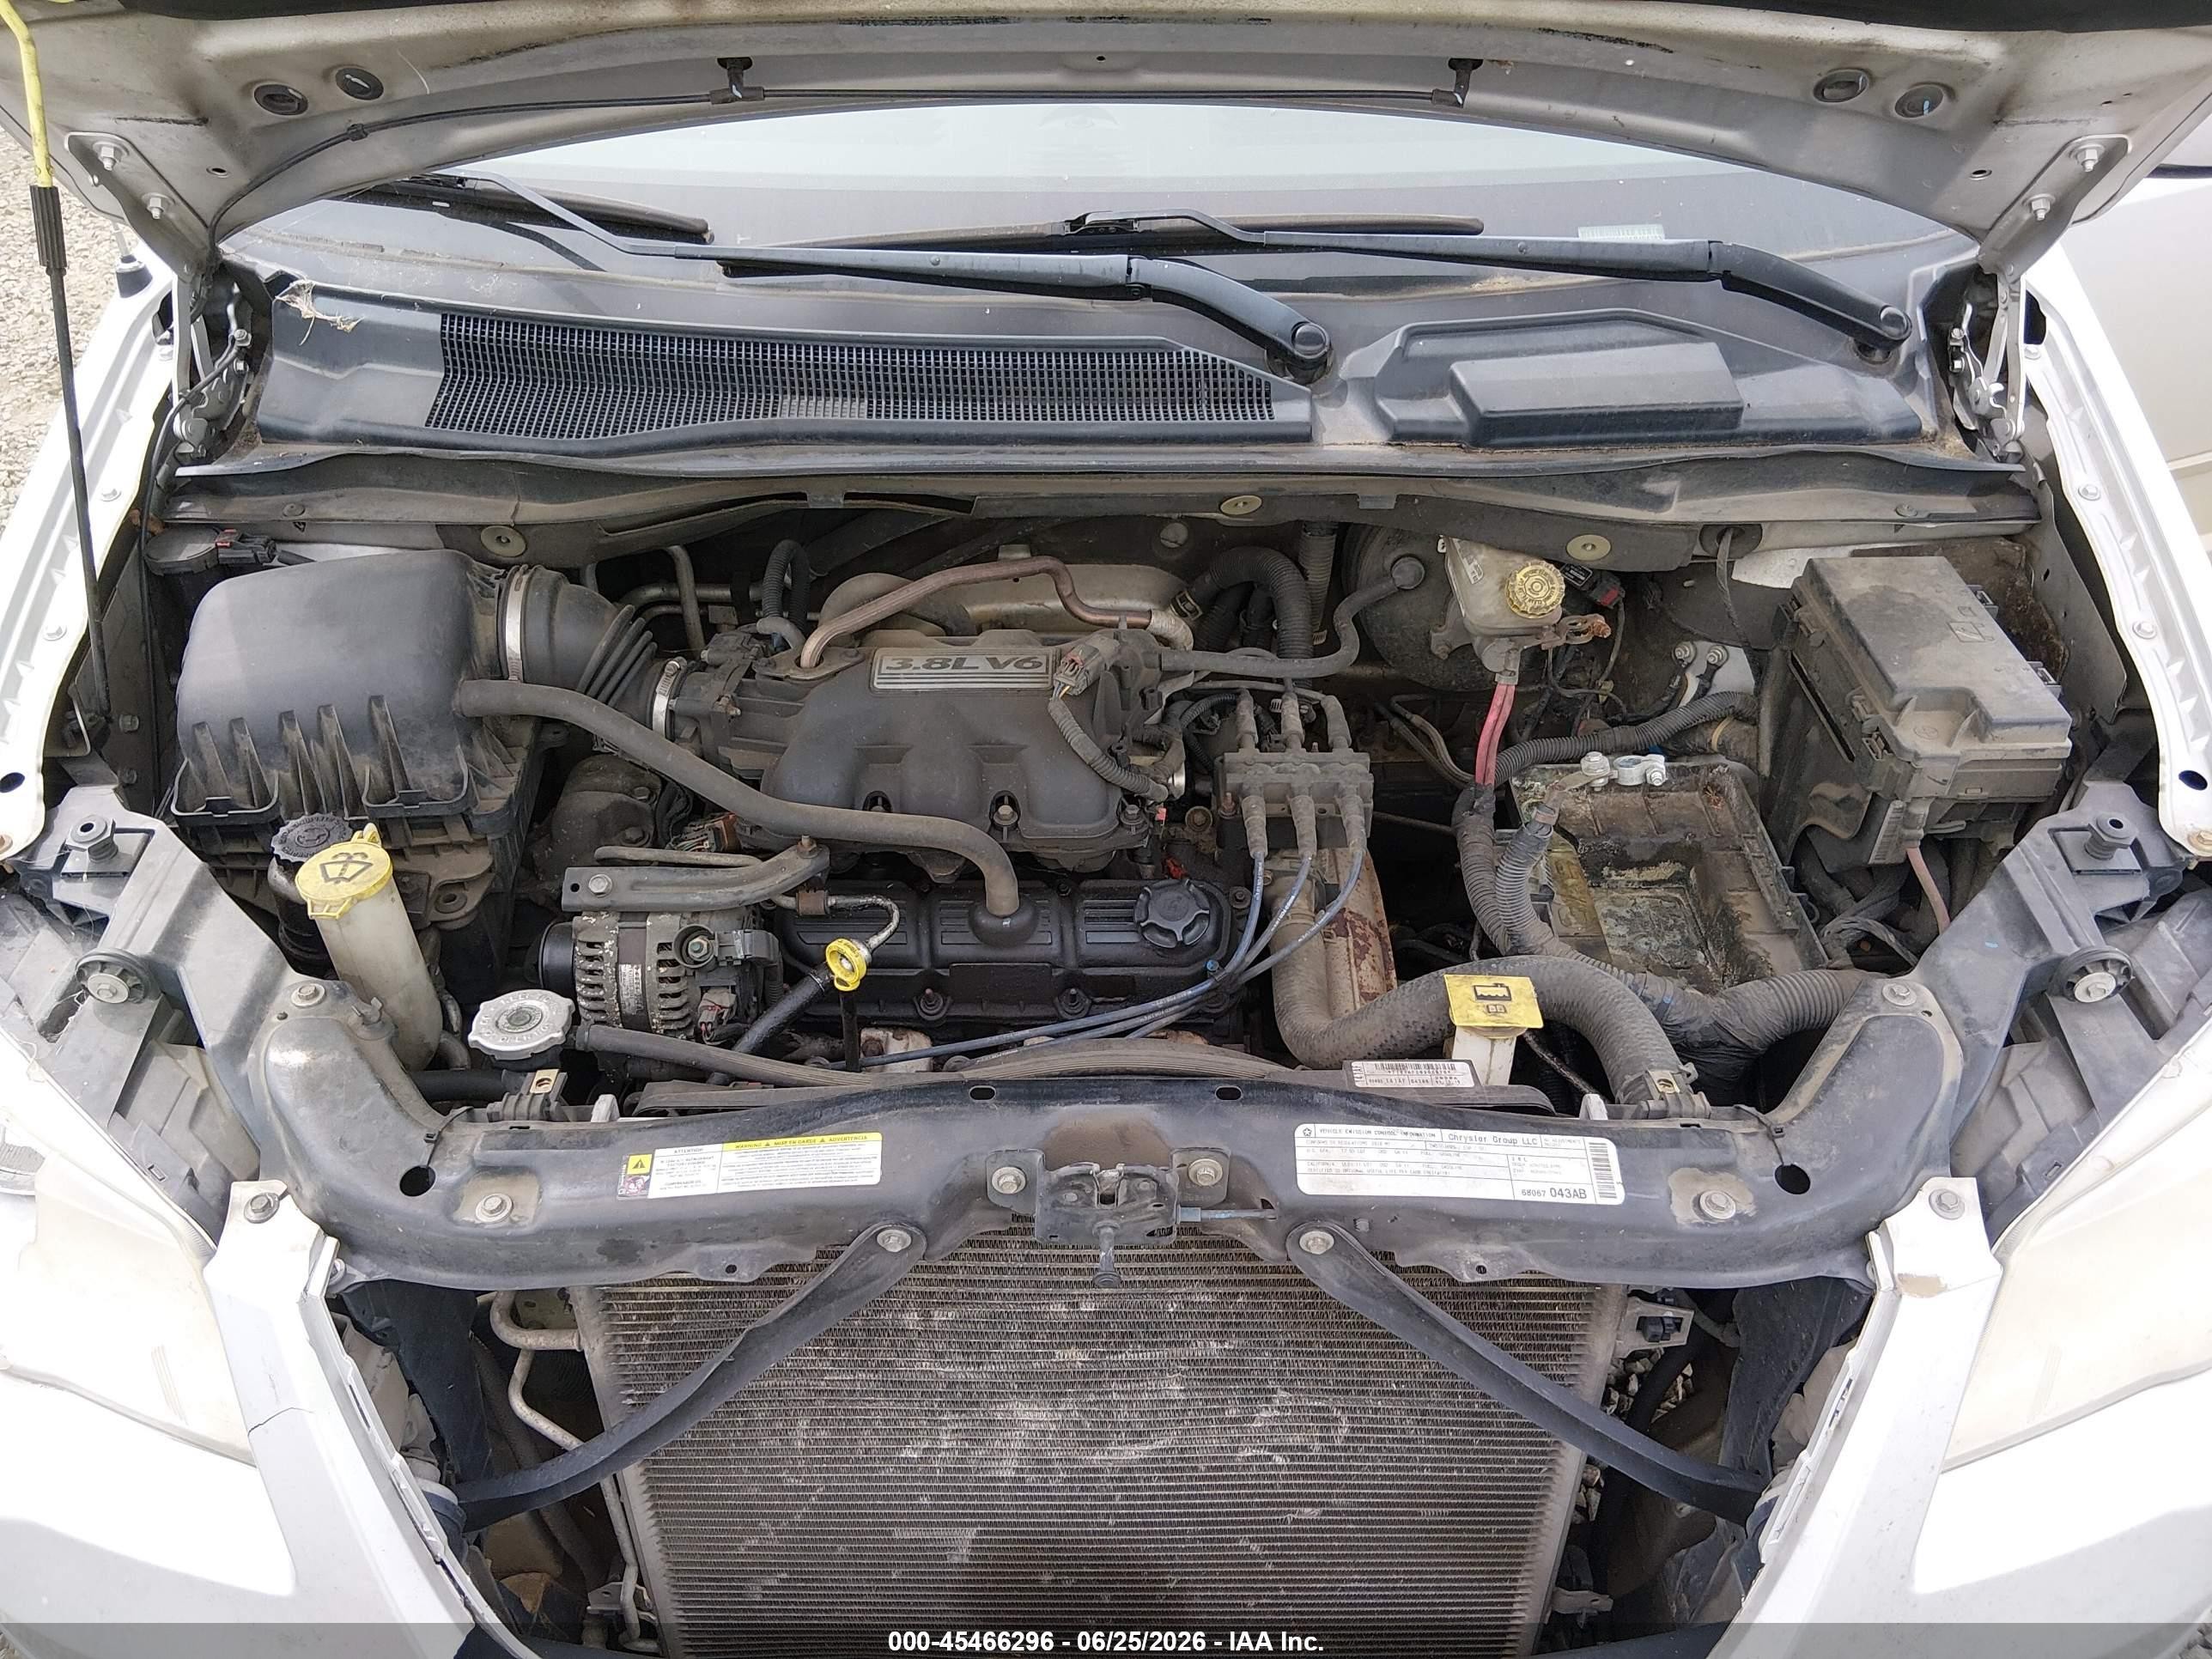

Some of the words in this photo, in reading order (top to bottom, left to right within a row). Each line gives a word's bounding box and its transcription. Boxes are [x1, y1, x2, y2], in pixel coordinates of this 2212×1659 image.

[885, 657, 980, 671] 3.8L
[986, 656, 1043, 670] V6
[1492, 1135, 1519, 1146] Group
[1522, 1137, 1539, 1146] LLC
[1522, 1188, 1547, 1198] 68067
[1550, 1187, 1587, 1200] 043AB
